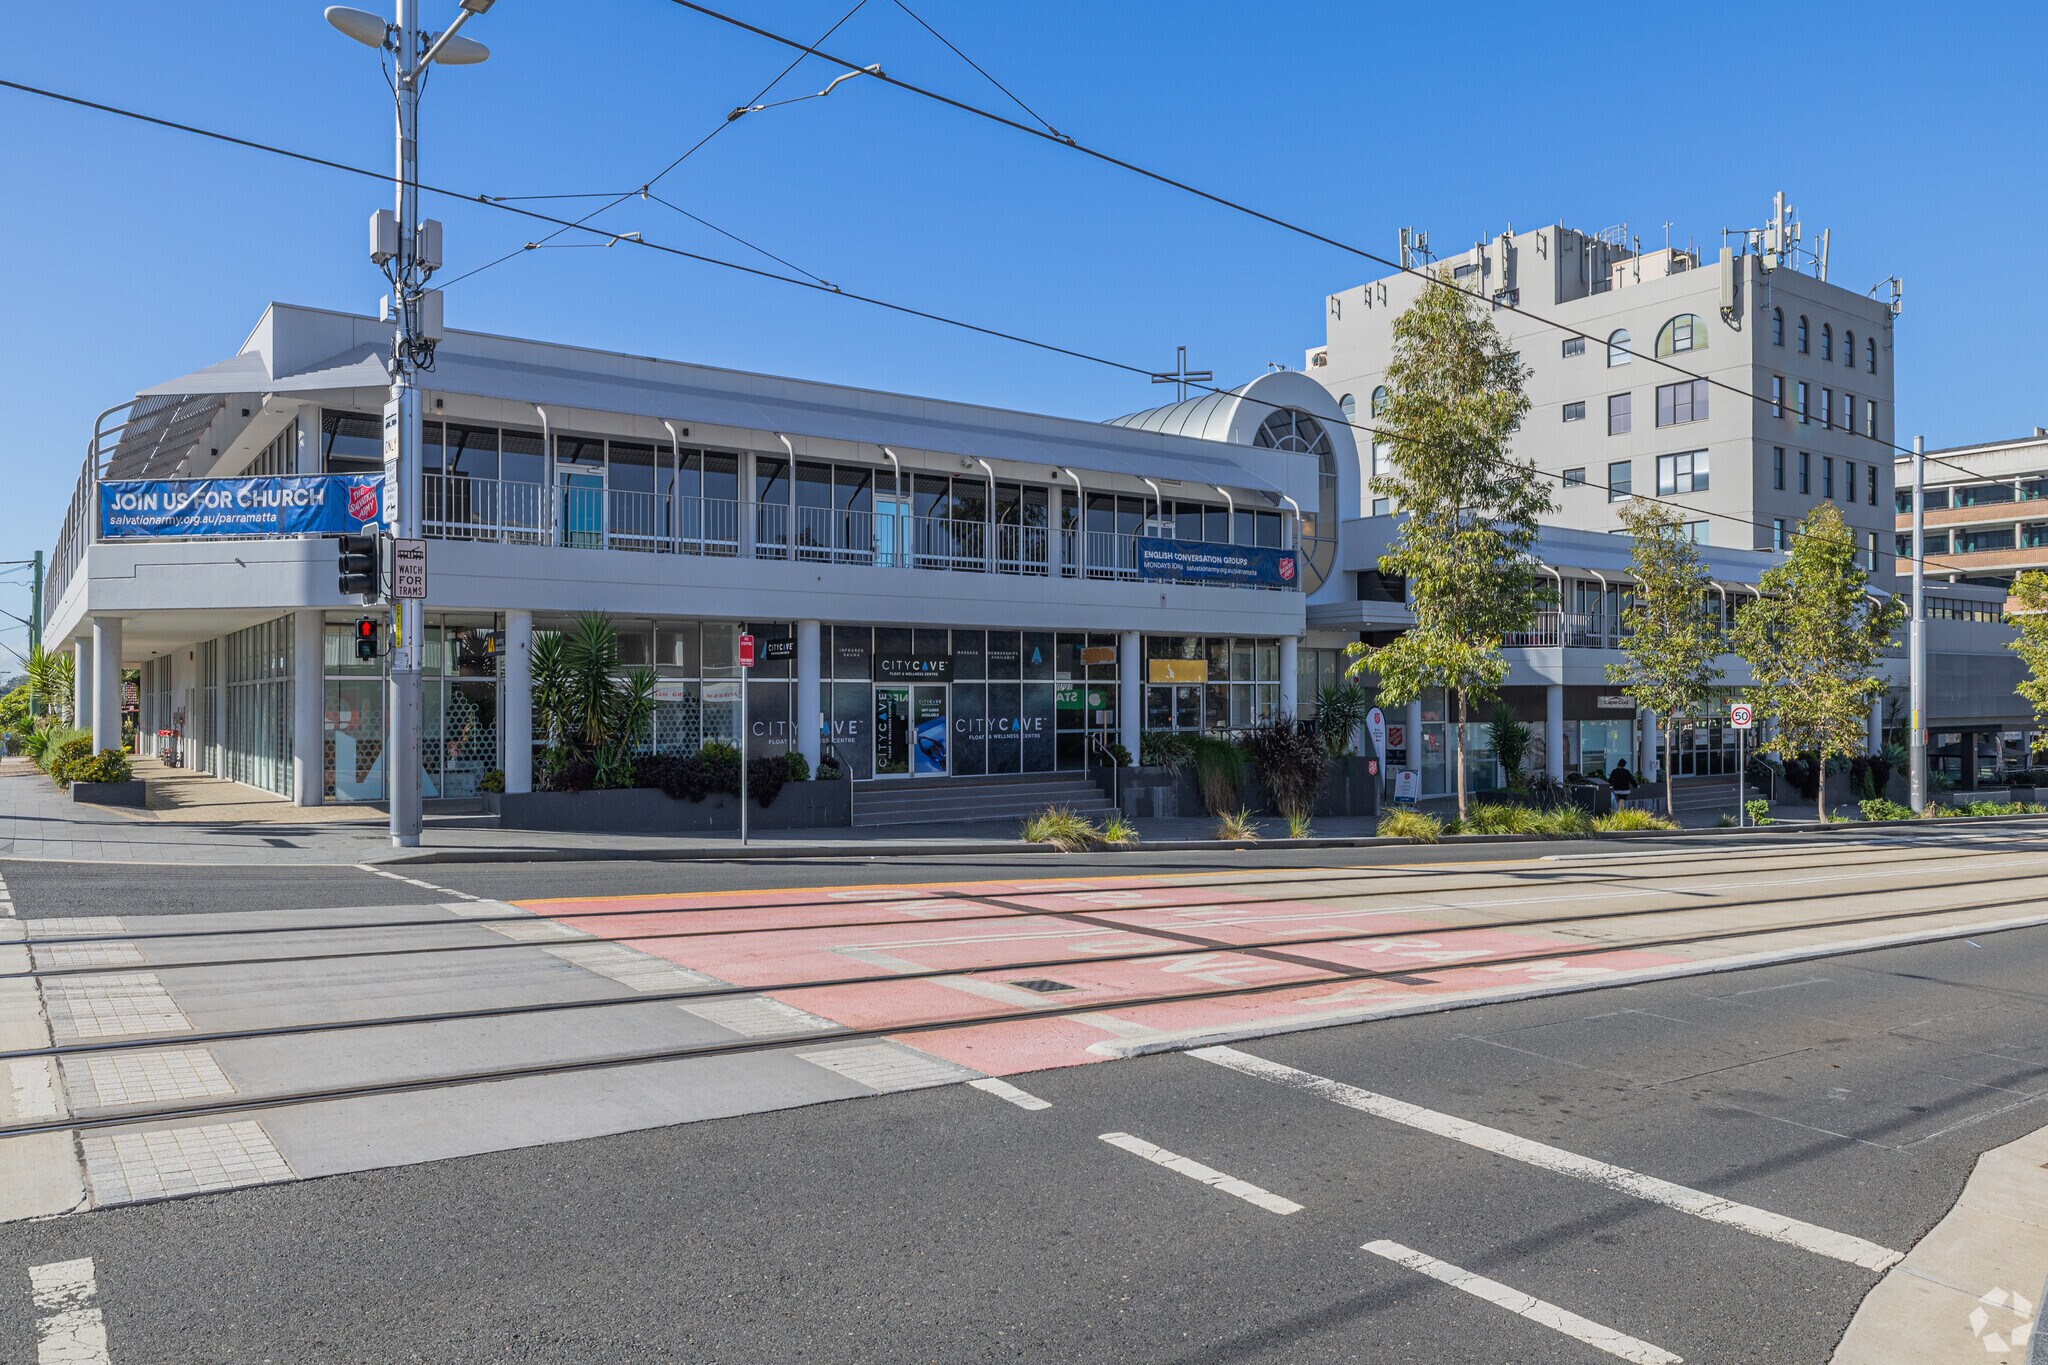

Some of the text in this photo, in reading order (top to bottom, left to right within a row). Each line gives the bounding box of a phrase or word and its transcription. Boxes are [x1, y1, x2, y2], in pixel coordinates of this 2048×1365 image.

[111, 488, 324, 511] JOIN US FOR CHURCH
[350, 489, 376, 512] SALVATION
[353, 488, 364, 500] THE
[358, 500, 374, 518] ARMY
[110, 512, 277, 526] salvationarmy.org.au/parramatta
[1144, 551, 1248, 566] ENGLISH CONVERSATION GROUPS
[399, 565, 422, 575] WATCH
[399, 576, 422, 585] FOR
[399, 586, 422, 596] TRAMS
[1735, 712, 1748, 721] 50
